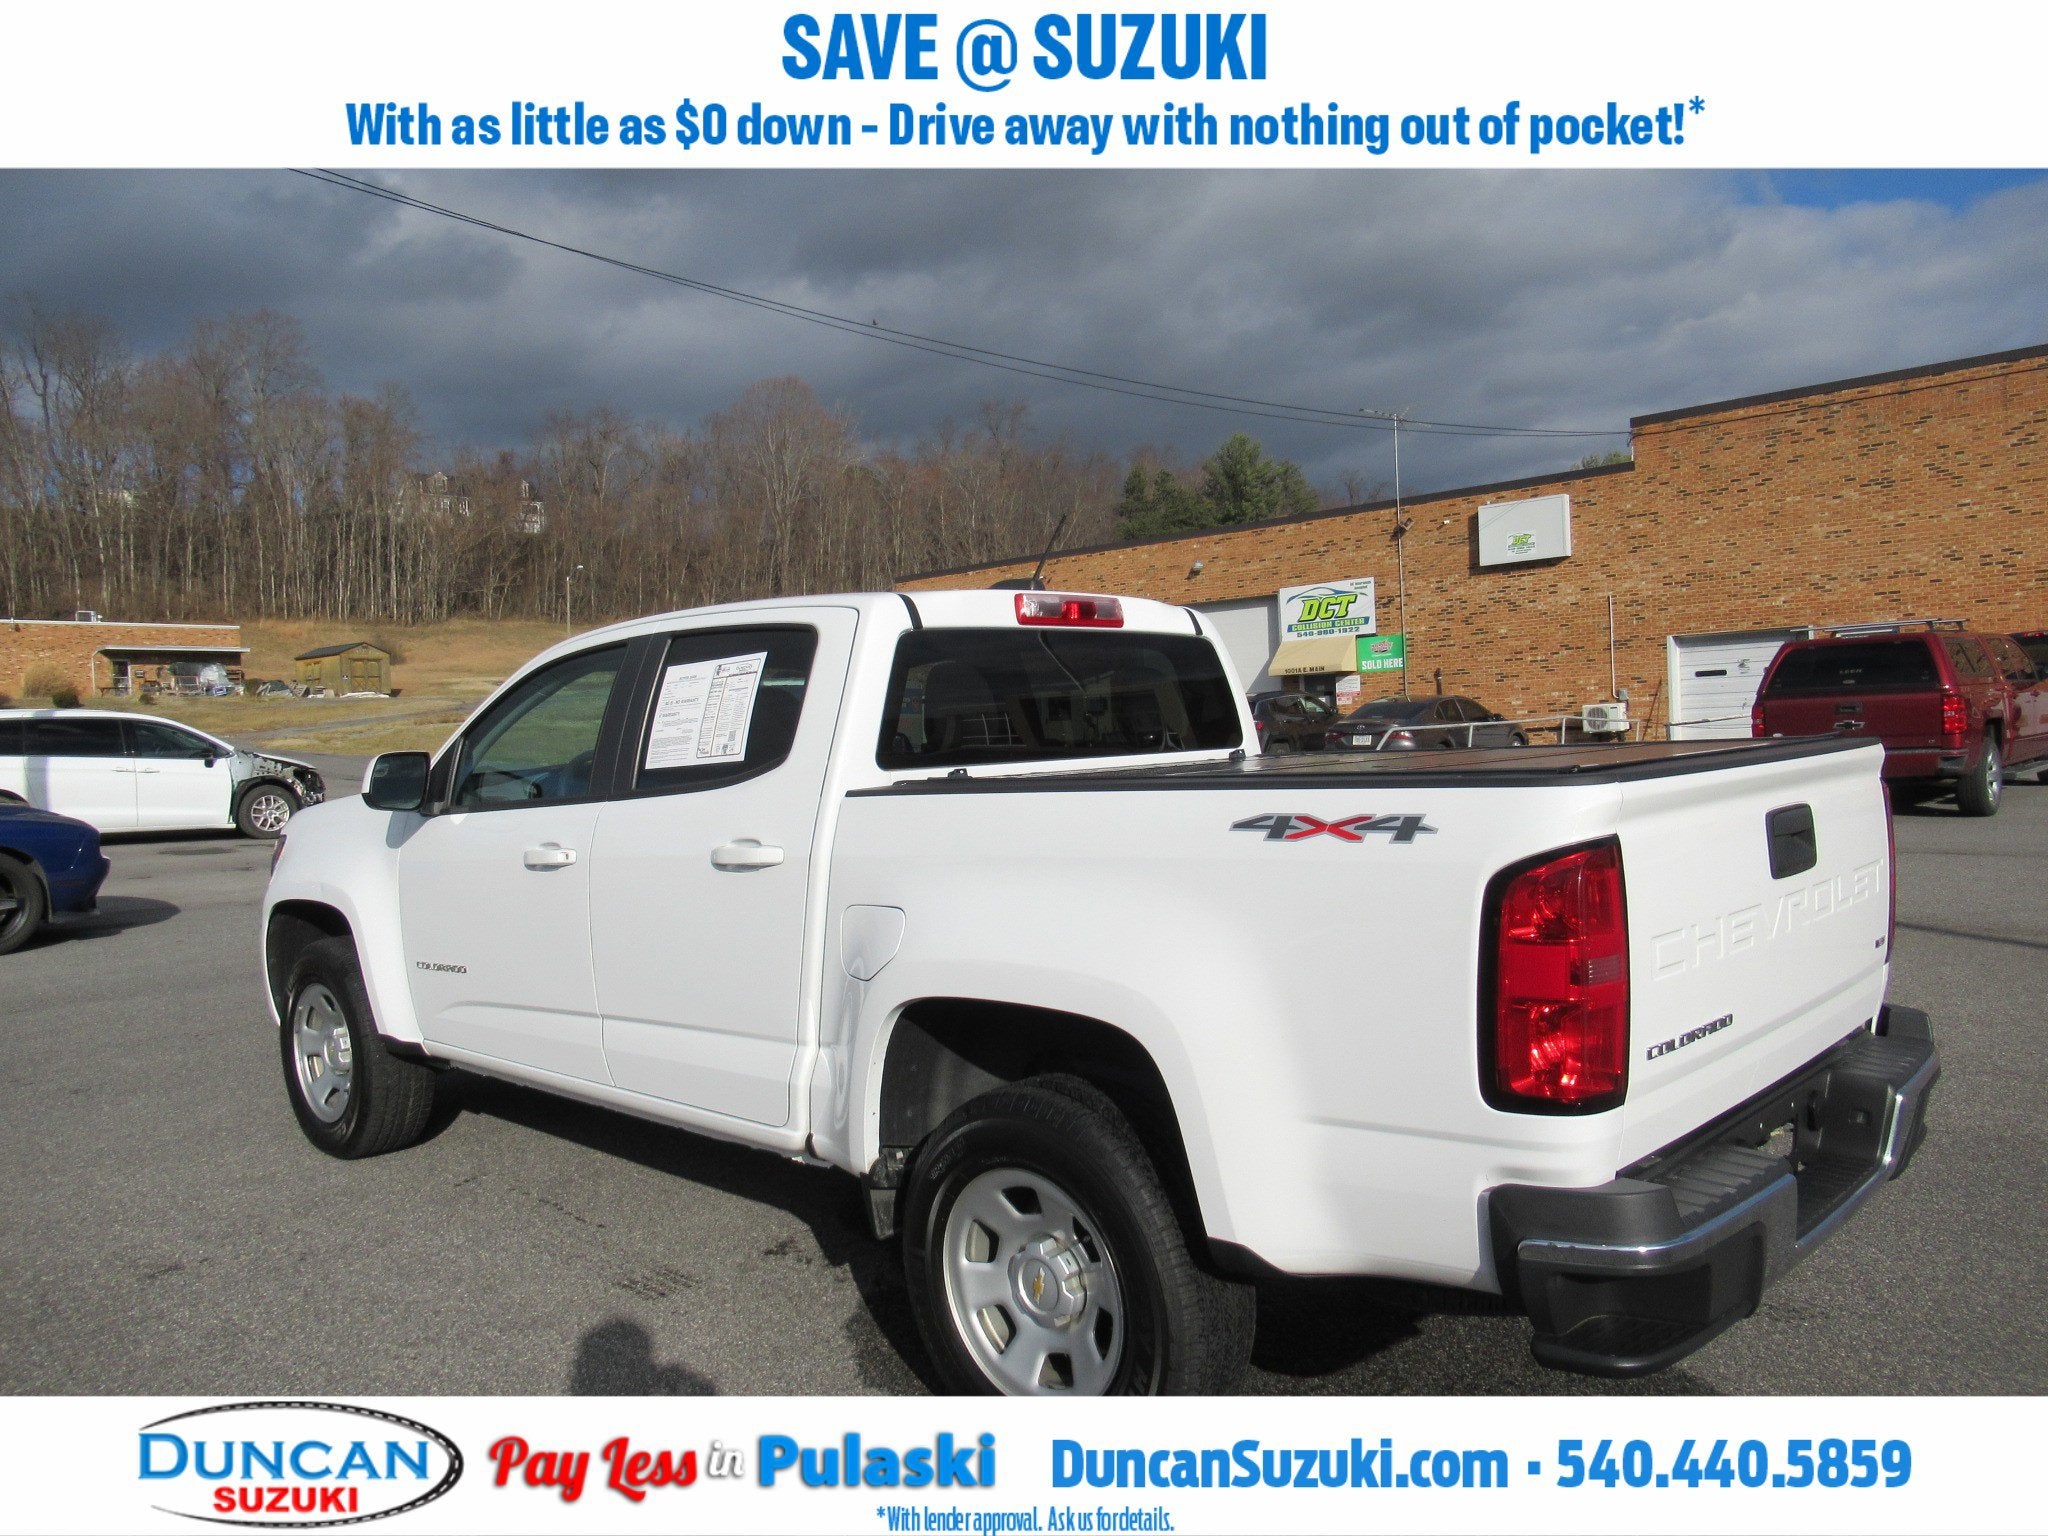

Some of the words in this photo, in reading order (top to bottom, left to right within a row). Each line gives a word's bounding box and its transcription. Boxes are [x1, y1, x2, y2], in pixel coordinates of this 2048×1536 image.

[1298, 594, 1358, 622] DCT
[1292, 621, 1332, 631] COLLISION
[1335, 617, 1364, 627] CENTER
[1362, 659, 1382, 670] SOLD
[1383, 658, 1403, 669] HERE
[1651, 857, 1884, 981] CHEVROLET
[416, 961, 467, 974] COLORADO
[1646, 1013, 1734, 1060] COLORADO
